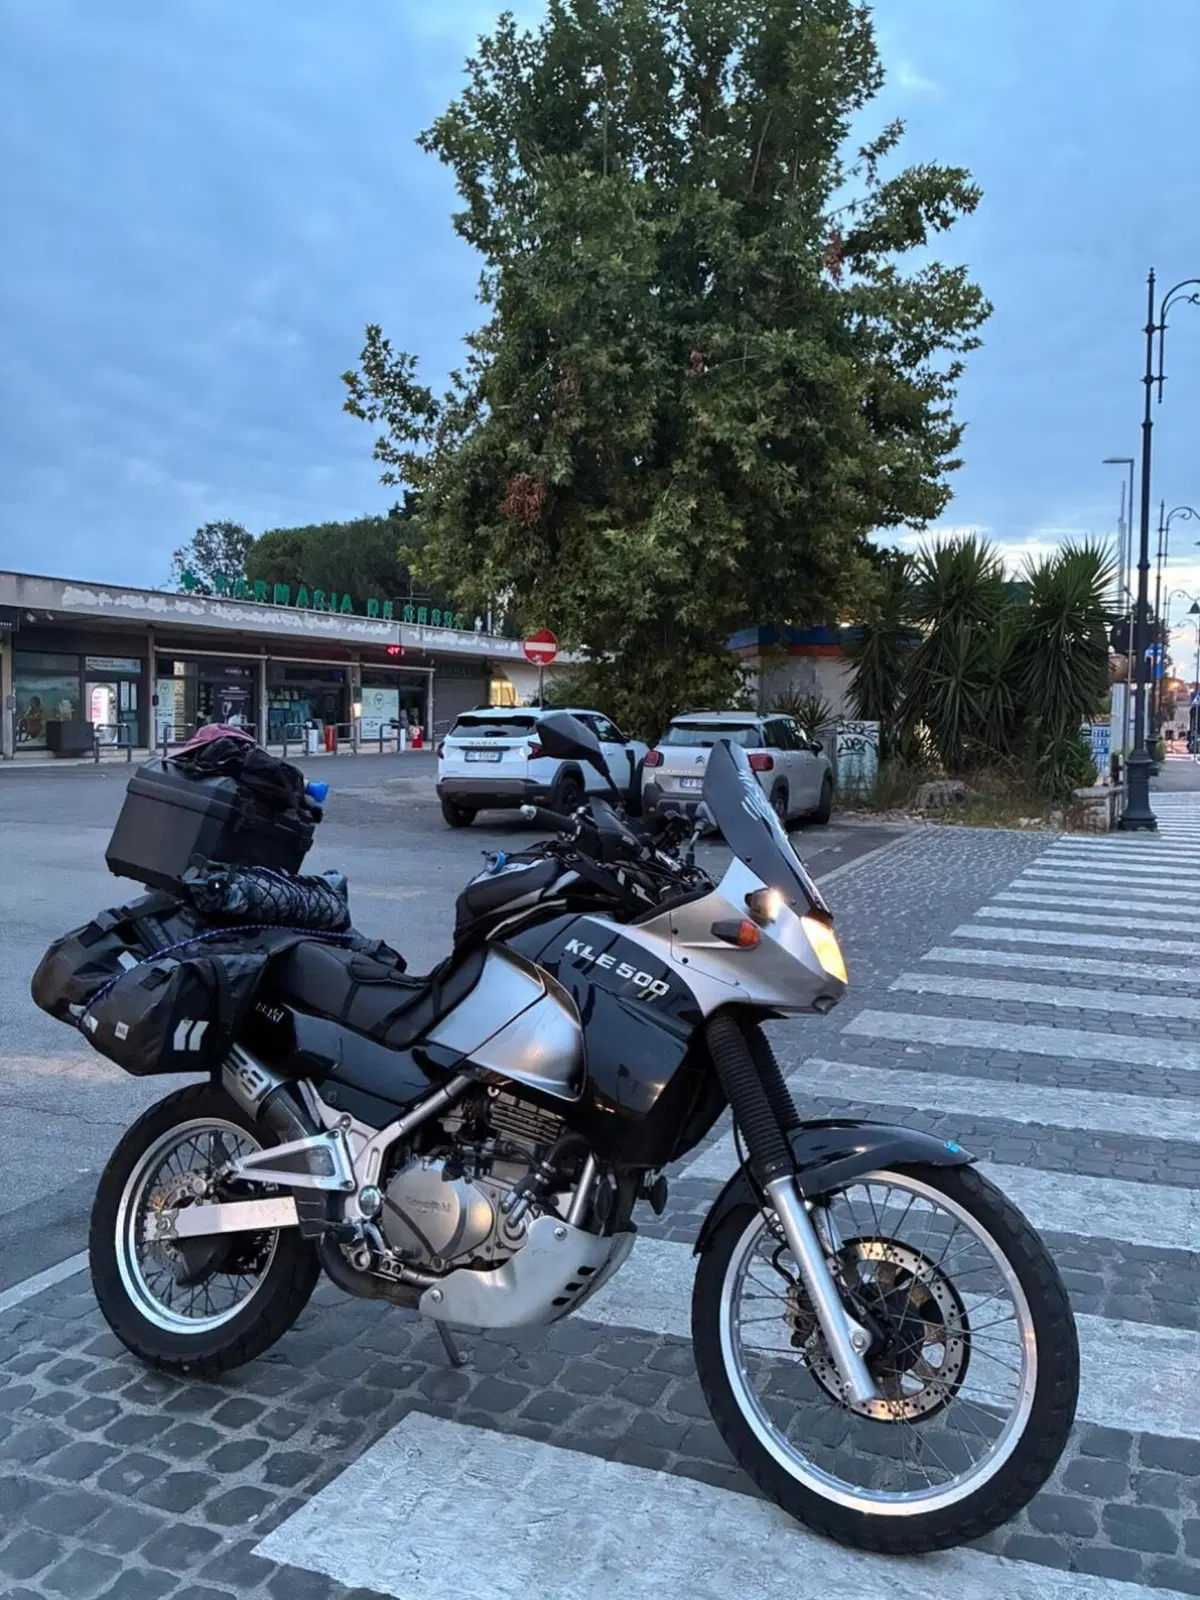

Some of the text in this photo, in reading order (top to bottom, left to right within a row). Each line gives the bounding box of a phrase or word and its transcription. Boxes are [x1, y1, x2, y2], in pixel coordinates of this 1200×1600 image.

[215, 574, 353, 613] FARMACIA
[367, 598, 394, 620] DE
[564, 938, 671, 996] KLE 500
